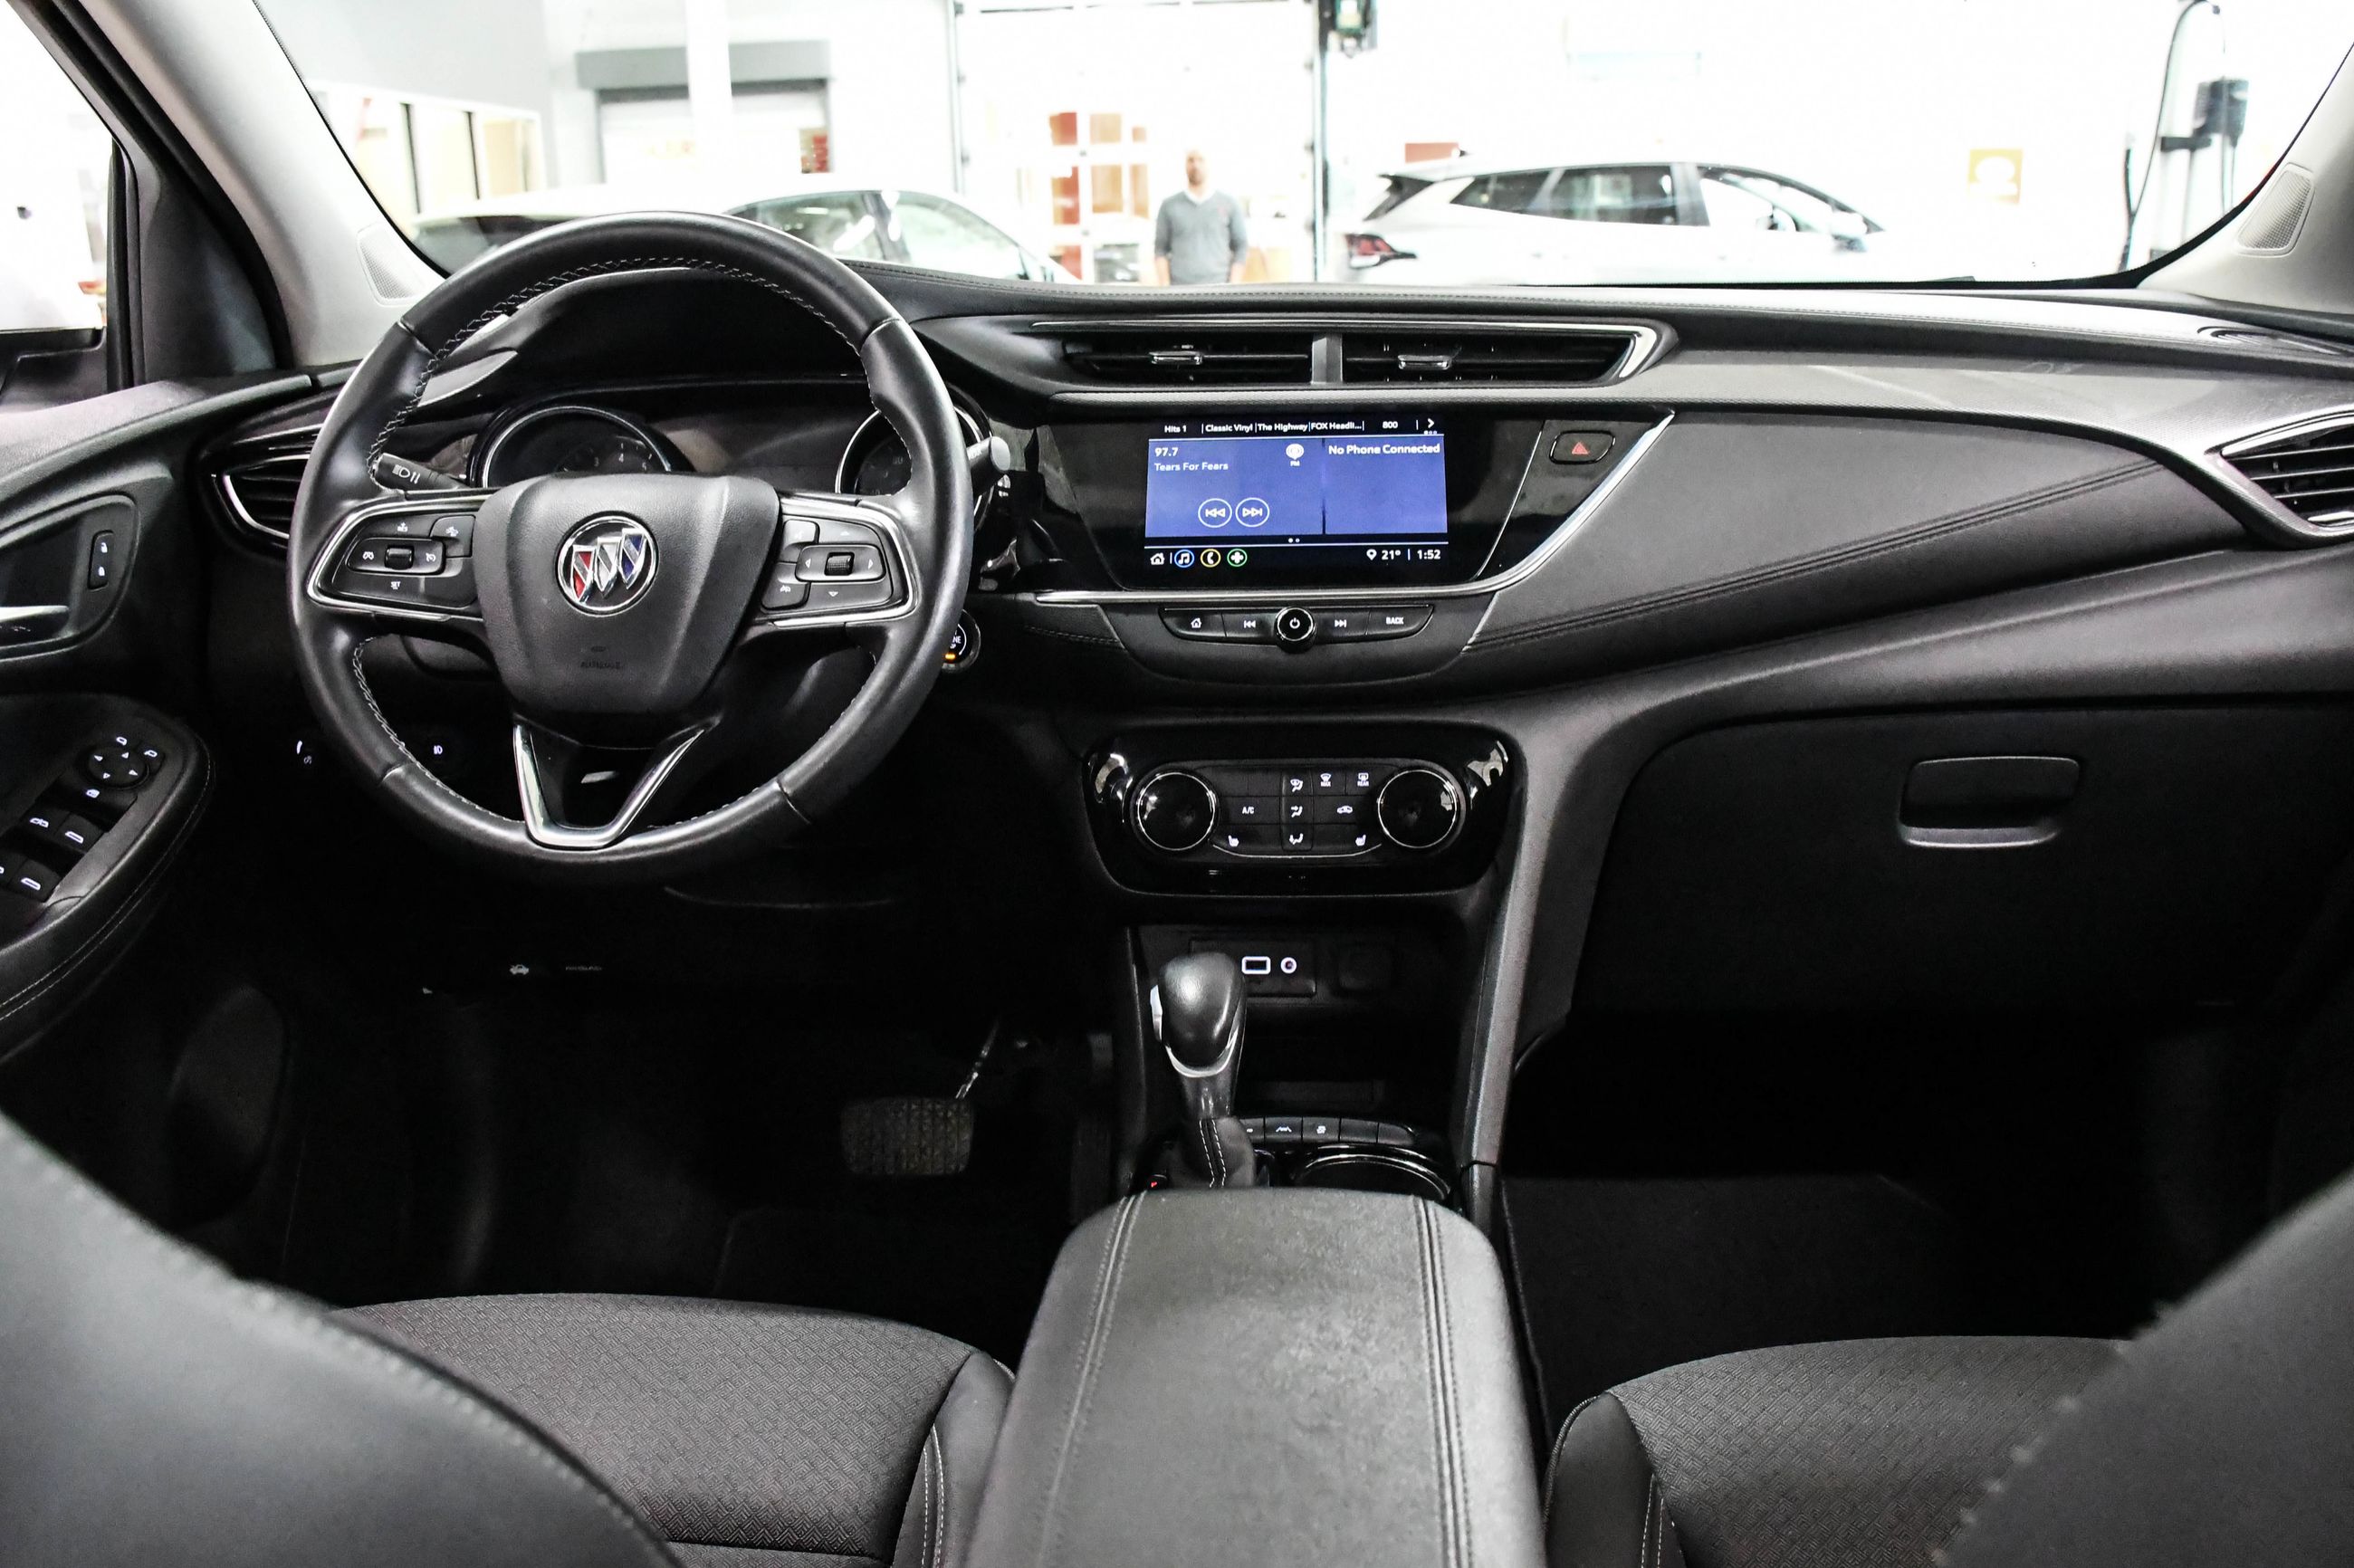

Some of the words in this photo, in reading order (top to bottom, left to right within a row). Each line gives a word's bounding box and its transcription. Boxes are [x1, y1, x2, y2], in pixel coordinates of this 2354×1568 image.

[1164, 425, 1181, 433] Hits
[1182, 425, 1187, 433] 1
[1205, 424, 1232, 432] Classic
[1233, 424, 1253, 434] Vinyl
[1258, 423, 1272, 431] The
[1274, 423, 1308, 432] Highway
[1154, 447, 1179, 456] 97.7
[1328, 445, 1344, 454] No
[1346, 444, 1381, 454] Phone
[1383, 443, 1440, 454] Connected
[1154, 463, 1181, 471] Tears
[1182, 462, 1199, 471] For
[1201, 462, 1229, 471] Fears
[1382, 550, 1402, 560] 21°
[1417, 549, 1441, 559] 1:52
[1385, 617, 1404, 625] BACK
[1242, 806, 1255, 814] A/C
